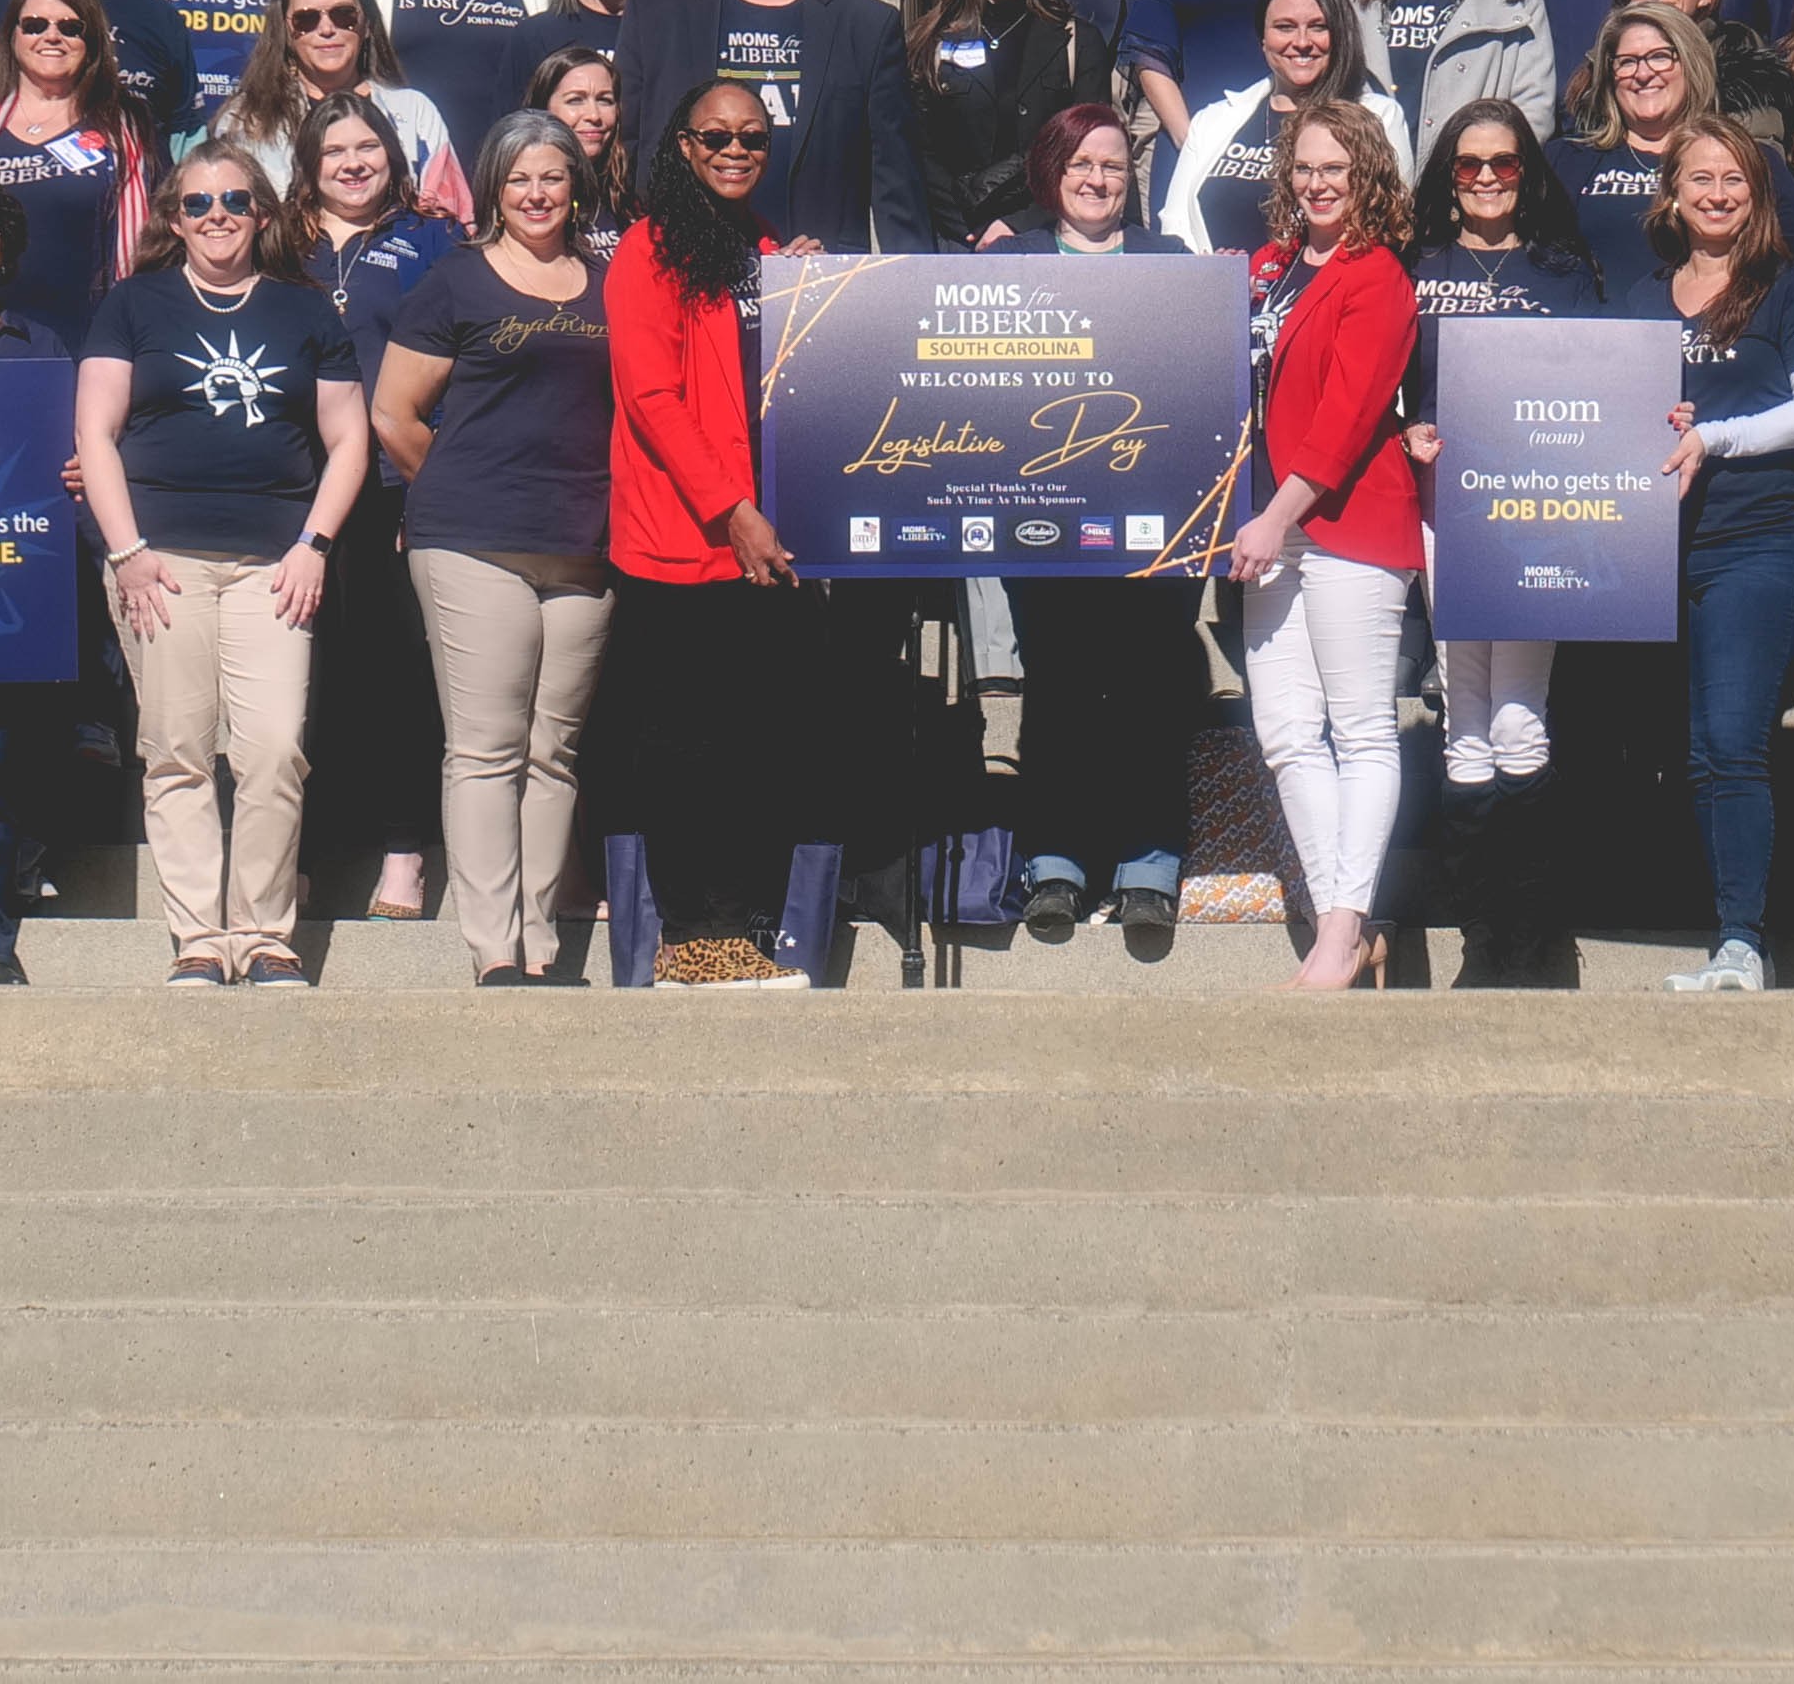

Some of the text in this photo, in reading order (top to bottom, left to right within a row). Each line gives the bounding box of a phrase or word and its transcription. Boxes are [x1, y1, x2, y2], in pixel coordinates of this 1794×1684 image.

[213, 12, 267, 33] DON
[467, 16, 518, 27] JOHN ADA
[1390, 5, 1435, 25] OMS
[728, 32, 779, 48] MOMS
[729, 47, 800, 64] LIBERT
[204, 84, 236, 96] IBER
[1227, 143, 1274, 163] OMS
[1590, 182, 1660, 196] LIBE
[935, 284, 1062, 310] MOMS for
[1415, 280, 1493, 299] MOMS
[935, 309, 1079, 335] LIBERTY
[930, 342, 1080, 356] SOUTH CAROLINA
[899, 372, 1114, 387] WELCOMES YOU TO
[1514, 399, 1601, 422] mom
[843, 390, 1170, 477] Legislative Day
[1529, 428, 1585, 448] (noun)
[946, 483, 1067, 494] Special Thanks To Our
[1461, 469, 1652, 495] One who gets the
[926, 495, 1087, 506] Such A Time As This Sponsors
[1487, 499, 1623, 521] JOB DONE.
[13, 512, 49, 532] the
[902, 532, 942, 541] LIBERTY
[1524, 566, 1561, 577] MOMS
[1524, 577, 1584, 589] LIBERTY
